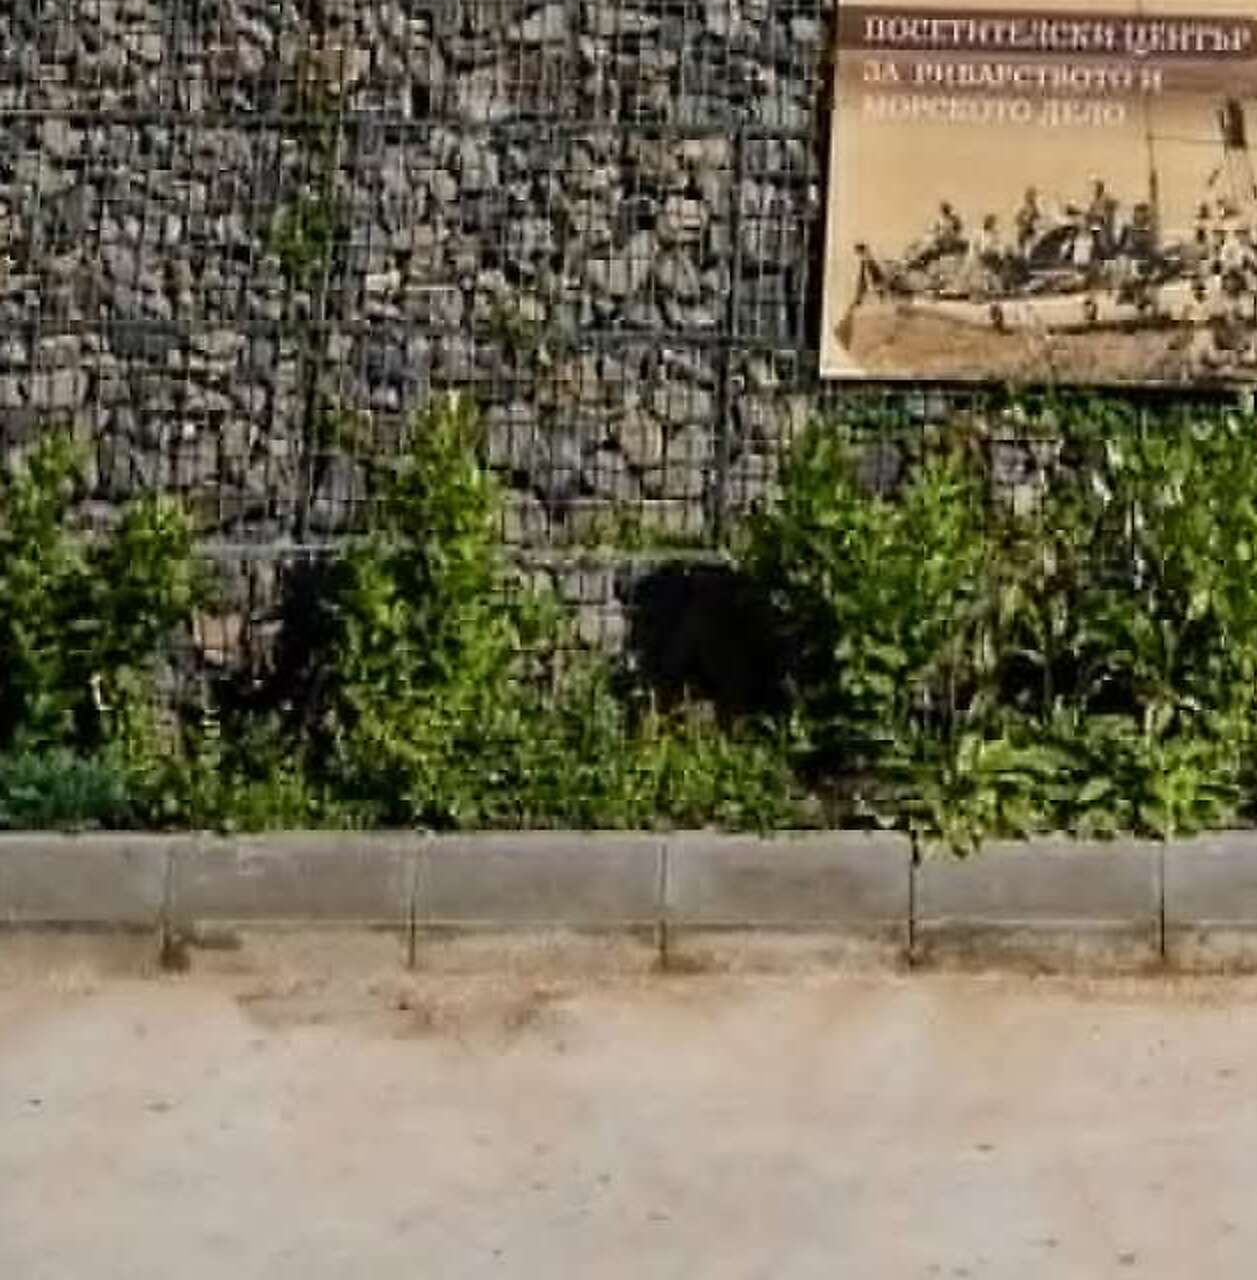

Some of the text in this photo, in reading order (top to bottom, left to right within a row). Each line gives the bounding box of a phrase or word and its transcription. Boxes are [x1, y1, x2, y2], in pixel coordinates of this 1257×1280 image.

[864, 16, 1251, 55] ПОСЕТИТЕЛСКИ ЦЕНТЪР
[863, 60, 899, 82] ЗА
